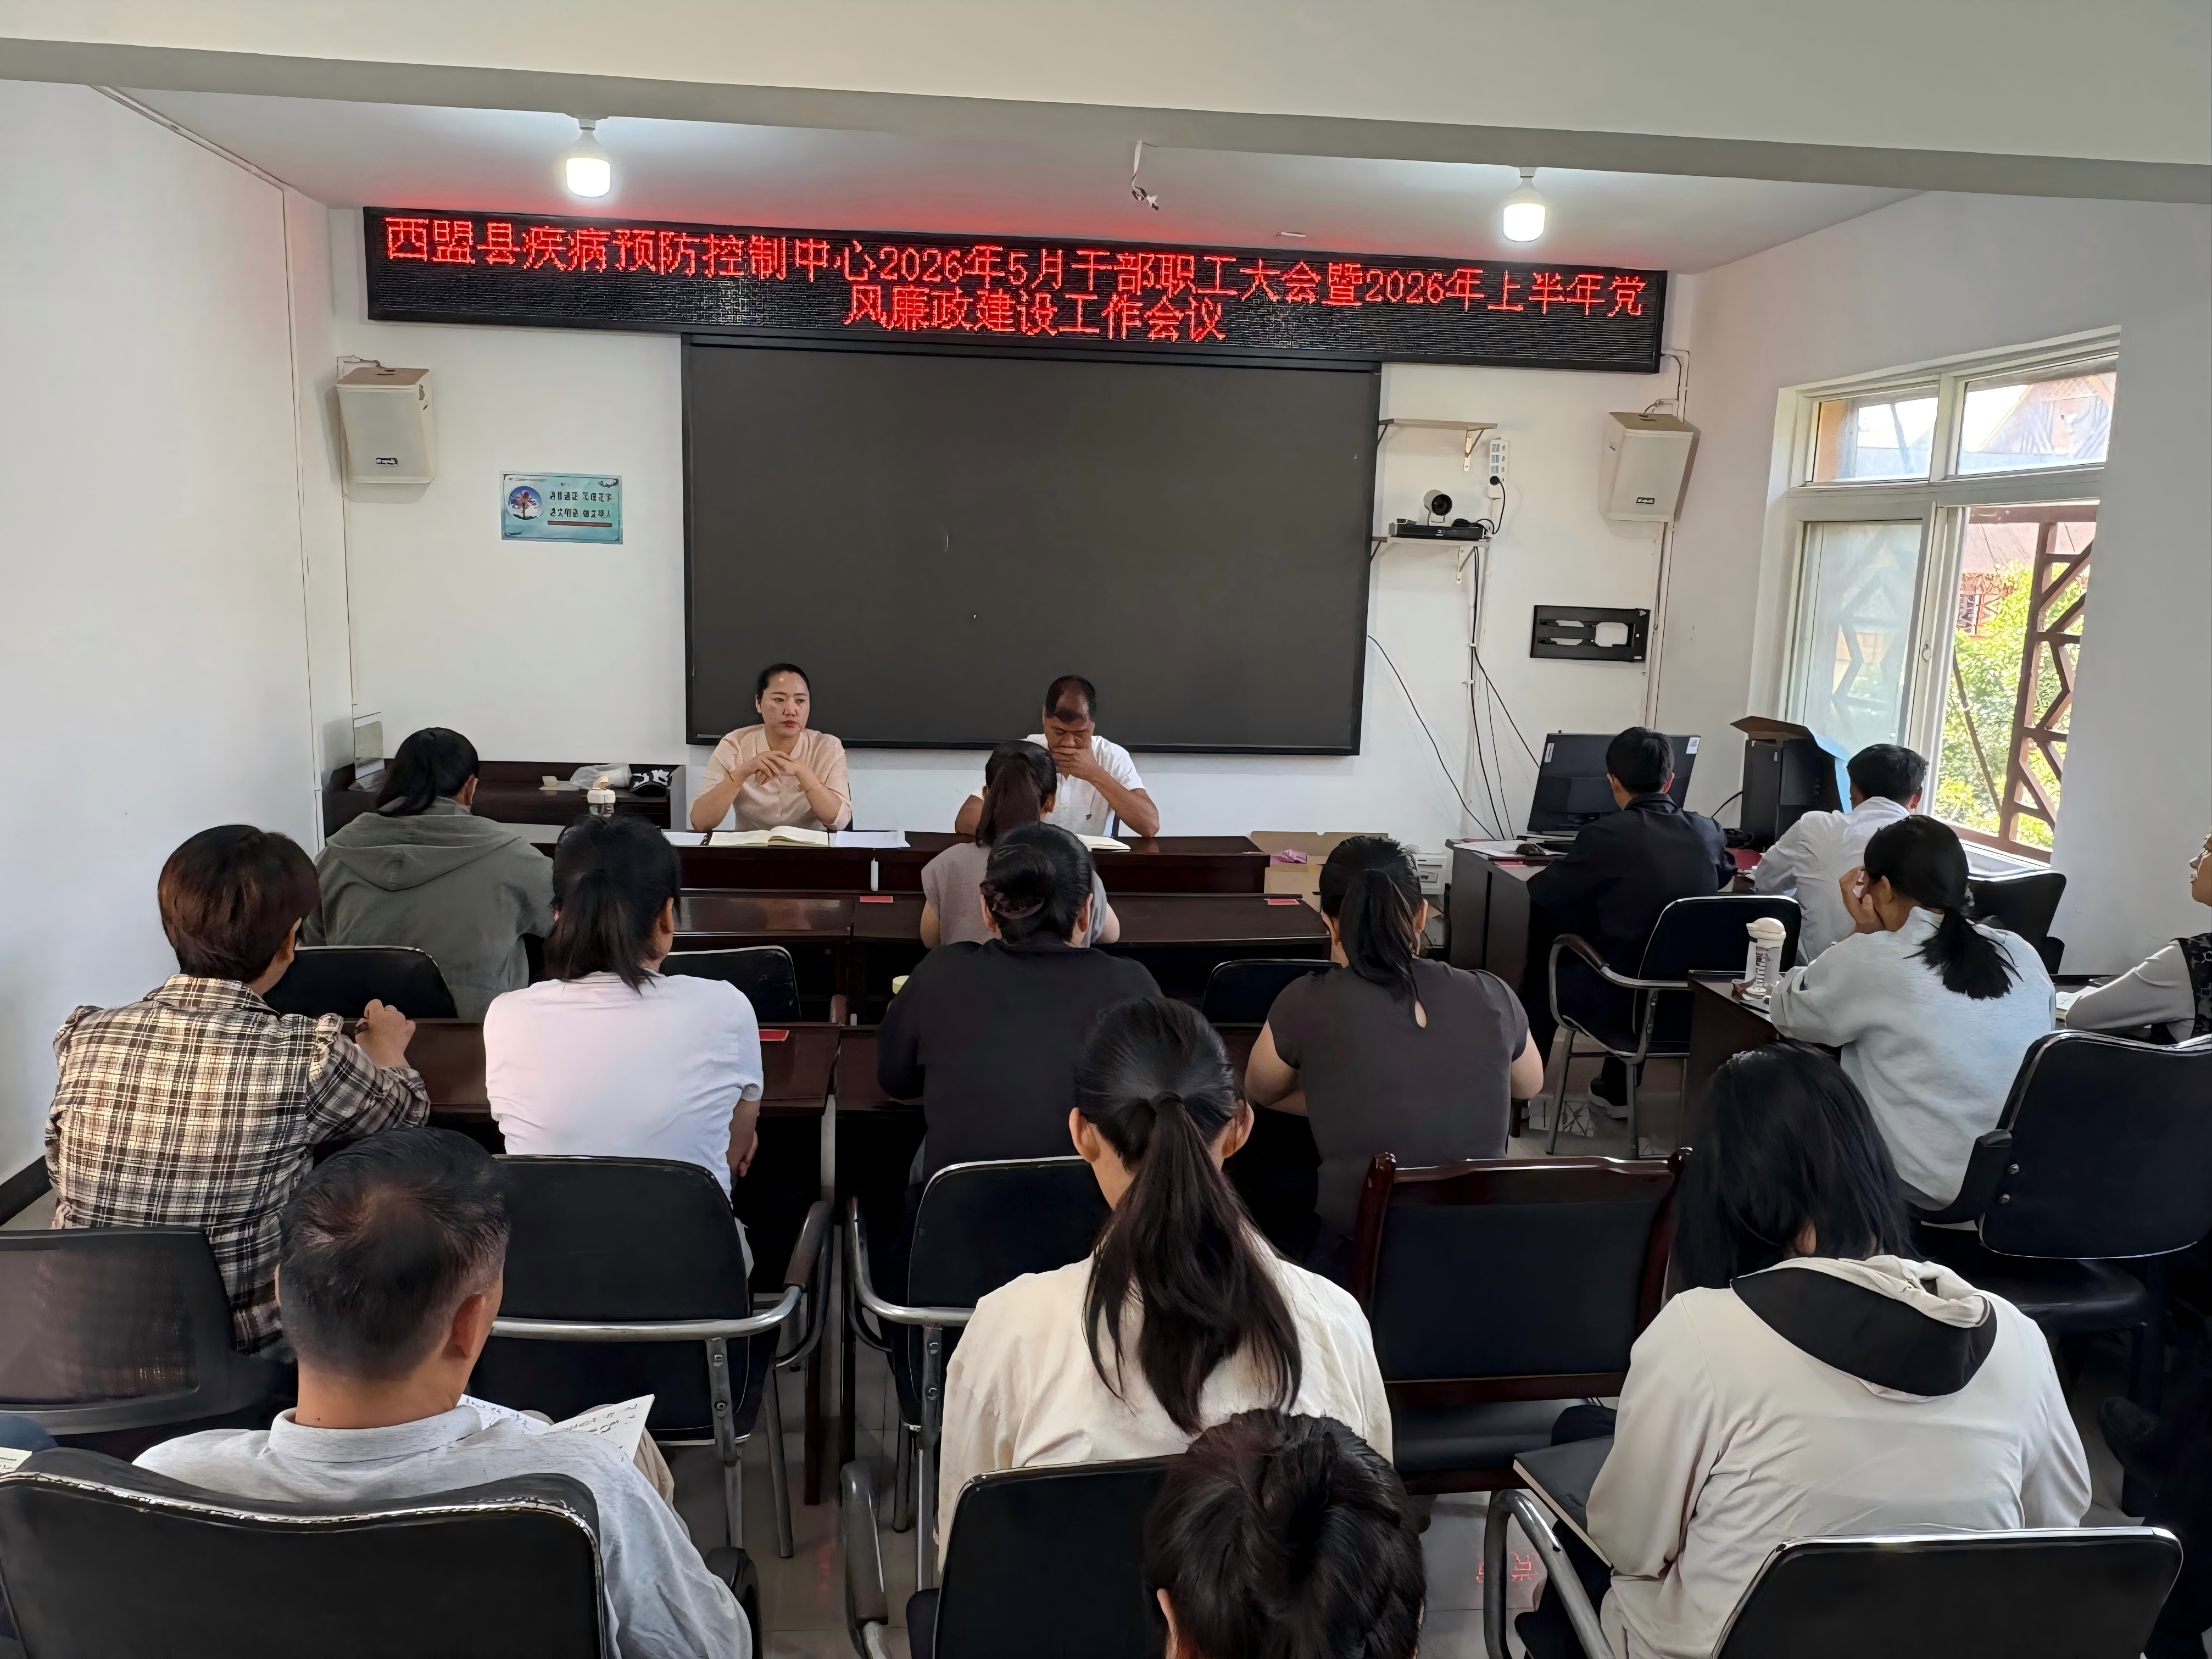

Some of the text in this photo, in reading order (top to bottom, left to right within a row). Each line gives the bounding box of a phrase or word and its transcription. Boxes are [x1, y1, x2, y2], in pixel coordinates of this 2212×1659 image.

[384, 216, 1647, 317] 西盟县疾病预防控制中心2026年5月干部职工大会暨2026年上半年党
[843, 283, 1227, 342] 风廉政建设工作会议
